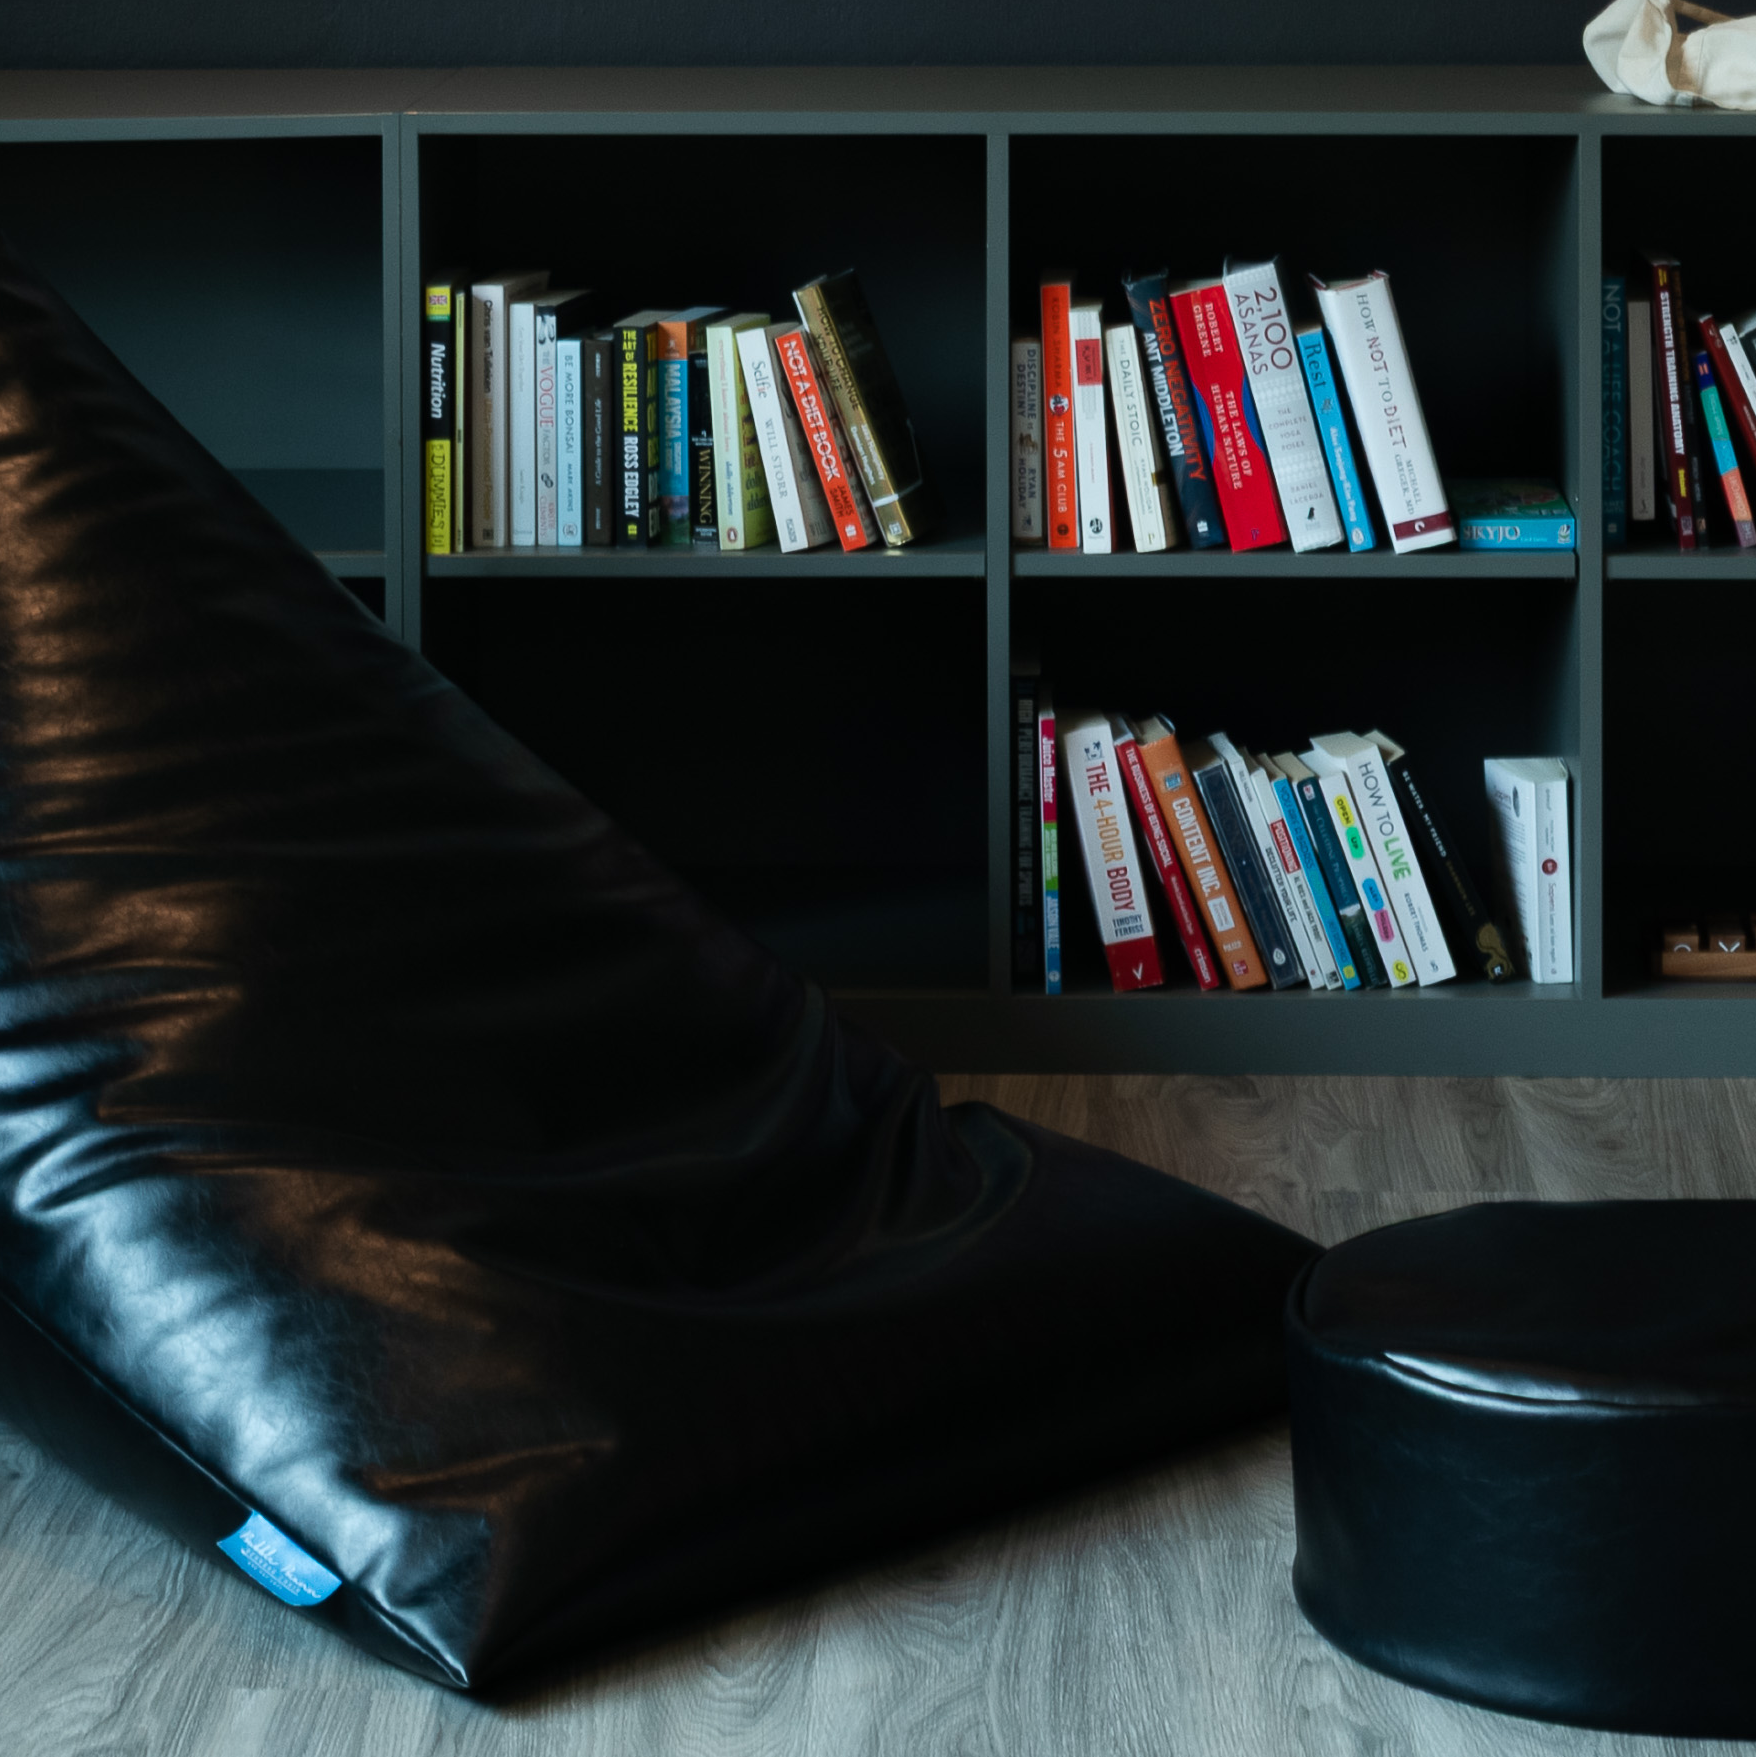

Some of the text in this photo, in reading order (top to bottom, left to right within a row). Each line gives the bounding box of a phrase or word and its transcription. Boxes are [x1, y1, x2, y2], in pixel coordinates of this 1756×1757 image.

[483, 300, 493, 326] Chris
[483, 330, 491, 348] van
[622, 330, 637, 341] THE
[622, 341, 636, 351] ART
[1051, 296, 1063, 388] ROBIN SHARMA
[1192, 304, 1211, 356] GREENE
[1204, 302, 1223, 352] ROBERT
[1234, 293, 1268, 375] ASANAS
[1253, 286, 1293, 370] 2,100
[430, 343, 445, 418] Nutrition
[751, 360, 770, 398] Selfie
[814, 332, 843, 392] YOUR LIFE
[816, 306, 862, 412] HOW TO CHANGE
[1016, 363, 1026, 417] DESTINY
[1025, 349, 1036, 419] DISCIPLINE
[1119, 358, 1135, 400] DAILY
[1148, 298, 1204, 478] ZERO NEGATIVITY
[1303, 342, 1326, 388] Rest
[1355, 292, 1407, 448] HOW NOT TO DIET
[1603, 284, 1621, 492] NOT A LIFE COACH
[1659, 290, 1685, 456] STRENGTH TRAINING ANATOMY
[539, 351, 553, 465] THE VOGUE FACTOR
[564, 355, 573, 453] BE MORE BONSAI
[623, 363, 637, 432] RESILIENCE
[663, 364, 681, 438] MALAYSIA
[783, 340, 840, 480] NOT A DIET BOOK
[1125, 403, 1142, 447] STOIC
[1143, 331, 1184, 456] ANT MIDDLETON
[1268, 416, 1307, 430] COMPLETE
[1278, 406, 1291, 416] THE
[764, 418, 788, 498] WILL STORR
[1052, 421, 1067, 513] THE 5 AM CLUB
[1210, 384, 1242, 489] HUMAN NATURE
[1225, 390, 1252, 477] THE LAWS OF
[1279, 429, 1301, 440] YOGA
[429, 453, 445, 530] DUMMIES
[623, 436, 639, 518] ROSS EDGLEY
[698, 449, 711, 523] WINNING
[829, 487, 844, 517] SMITH
[836, 485, 854, 516] JAMES
[1017, 458, 1027, 508] HOLIDAY
[1027, 467, 1036, 499] RYAN
[1404, 458, 1422, 504] MICHAEL
[1463, 525, 1521, 541] SKYJO
[1041, 737, 1054, 803] Juice Master
[1085, 761, 1134, 910] THE 4-HOUR BODY
[1125, 746, 1172, 867] THE BUSINESS OF BEING SOCIAL
[1335, 797, 1359, 850] OPEN UP
[1357, 761, 1411, 880] HOW TO LIVE
[1172, 797, 1210, 863] CONTENT
[1195, 864, 1220, 897] INC.
[1273, 821, 1298, 874] POSITIONING
[1112, 914, 1143, 930] TIMOTHY
[1114, 924, 1145, 938] FERRISS
[1403, 891, 1428, 952] ROBERT THOMAS
